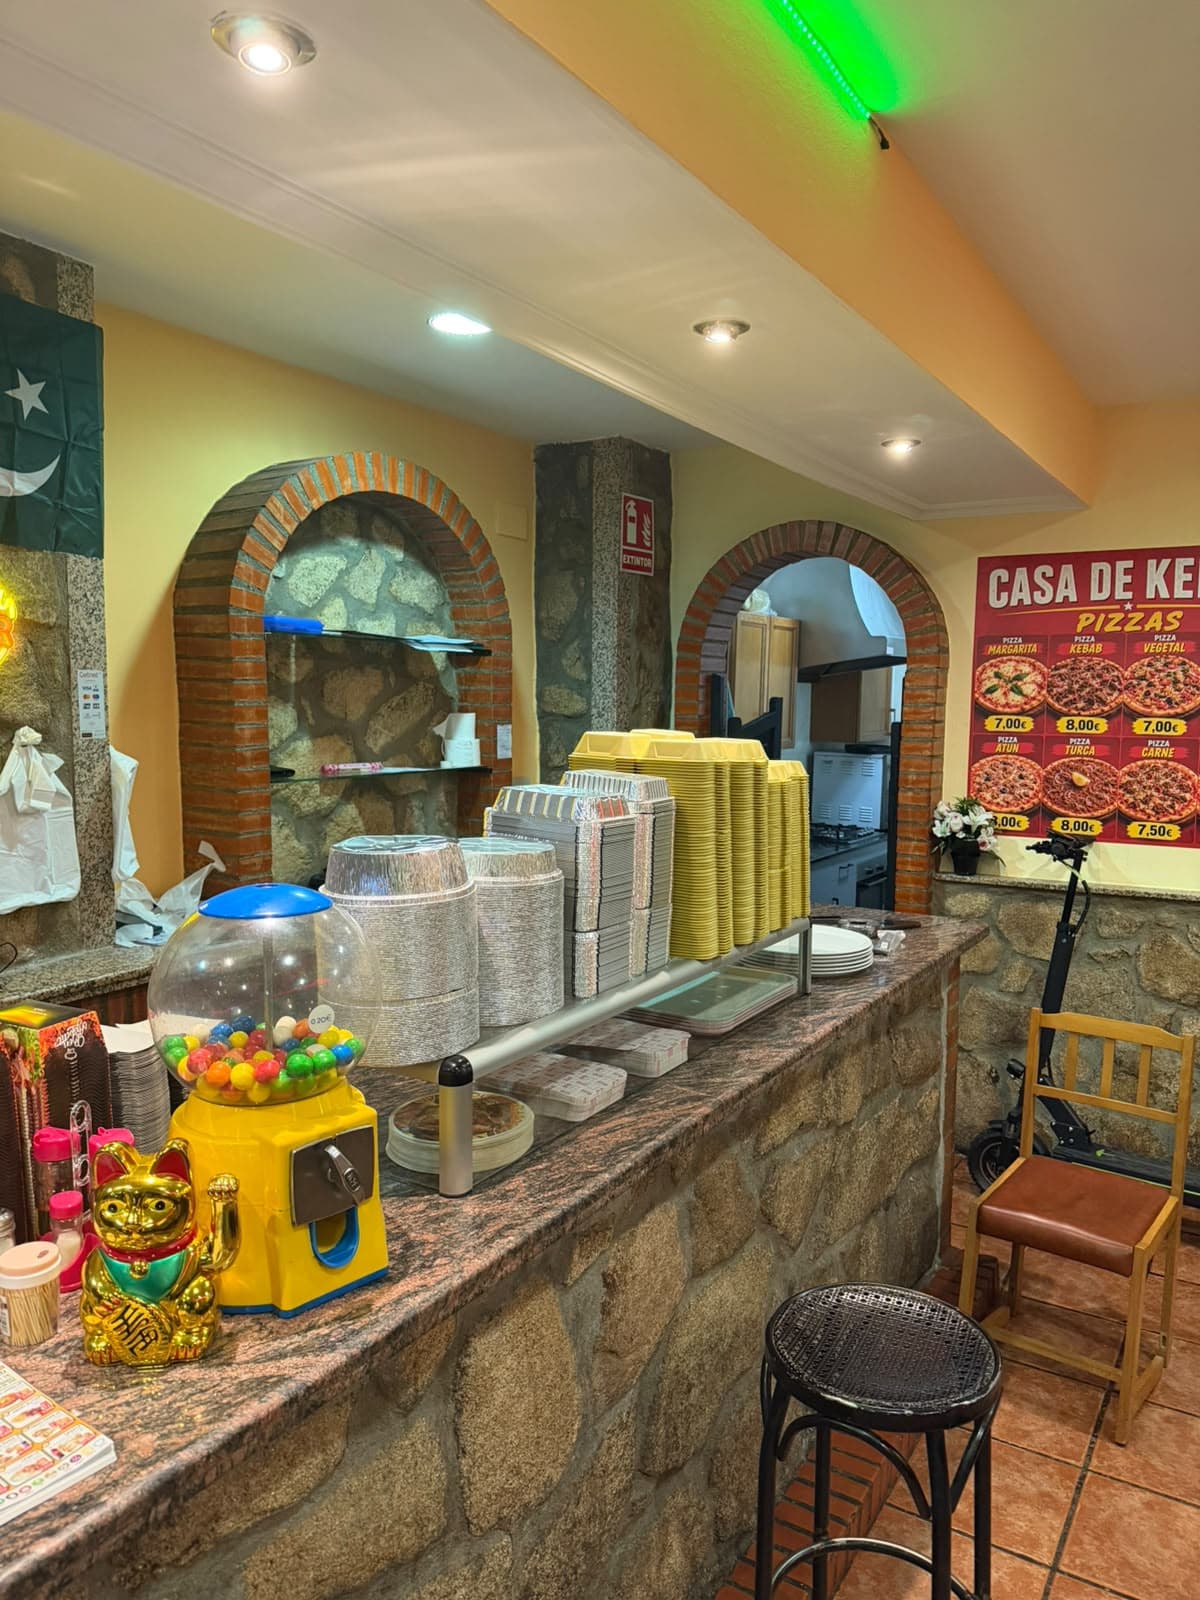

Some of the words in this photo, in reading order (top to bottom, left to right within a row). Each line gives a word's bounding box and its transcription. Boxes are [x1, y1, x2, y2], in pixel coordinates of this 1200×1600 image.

[988, 564, 1077, 609] CASA
[1090, 560, 1134, 601] DE
[1146, 557, 1200, 599] KE
[1076, 611, 1184, 633] PIZZAS
[1074, 635, 1095, 643] PIZZA
[987, 643, 1038, 655] MARGARITA
[1069, 643, 1103, 654] KEBAB
[1143, 641, 1185, 653] VEGETAL
[995, 717, 1027, 730] 7,00€
[1066, 719, 1100, 731] 8,00€
[1143, 720, 1178, 733] 7,00€
[997, 736, 1018, 744] PIZZA
[995, 742, 1019, 753] ATUN
[1065, 744, 1095, 756] TURCA
[1141, 747, 1175, 758] CARNE
[1060, 820, 1095, 832] 8,00€
[1137, 824, 1172, 837] 7,50€
